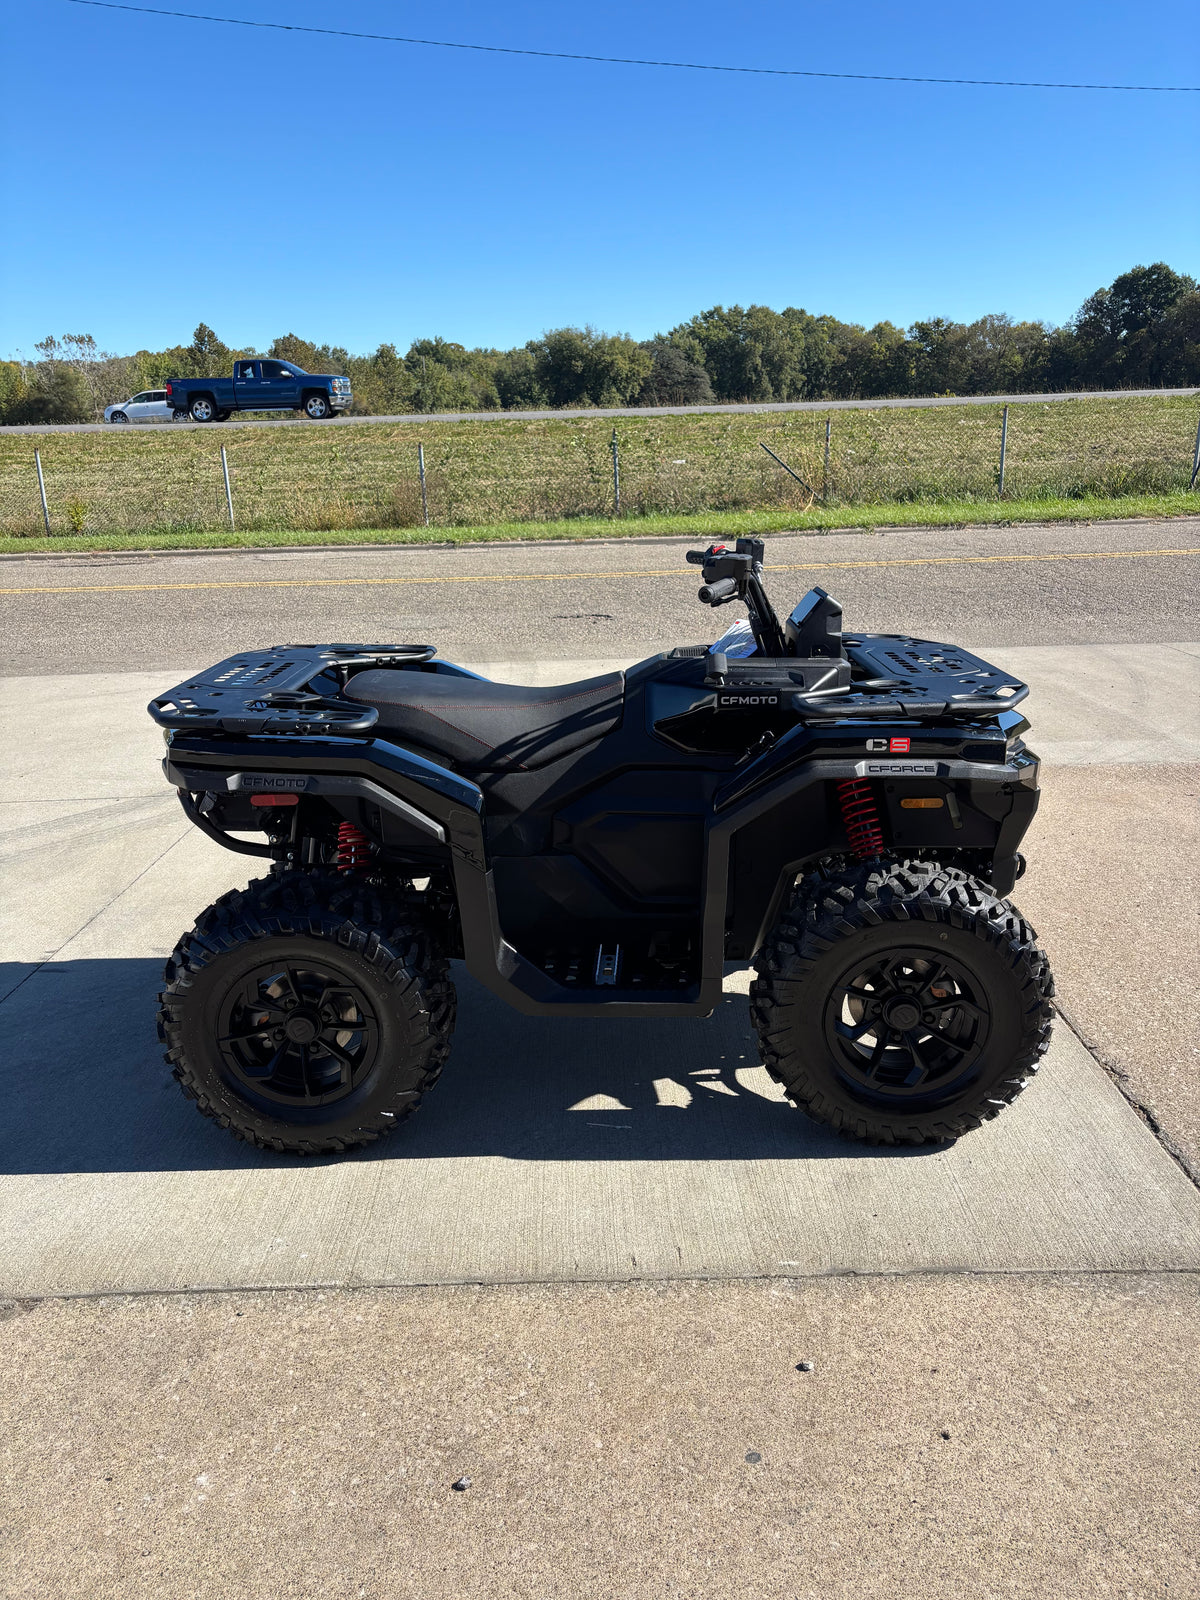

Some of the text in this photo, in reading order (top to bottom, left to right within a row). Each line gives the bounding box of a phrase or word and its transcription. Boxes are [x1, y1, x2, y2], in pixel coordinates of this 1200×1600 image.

[720, 696, 778, 705] CFMOTO
[868, 765, 936, 773] CFORCE
[242, 777, 306, 788] CFMOTO
